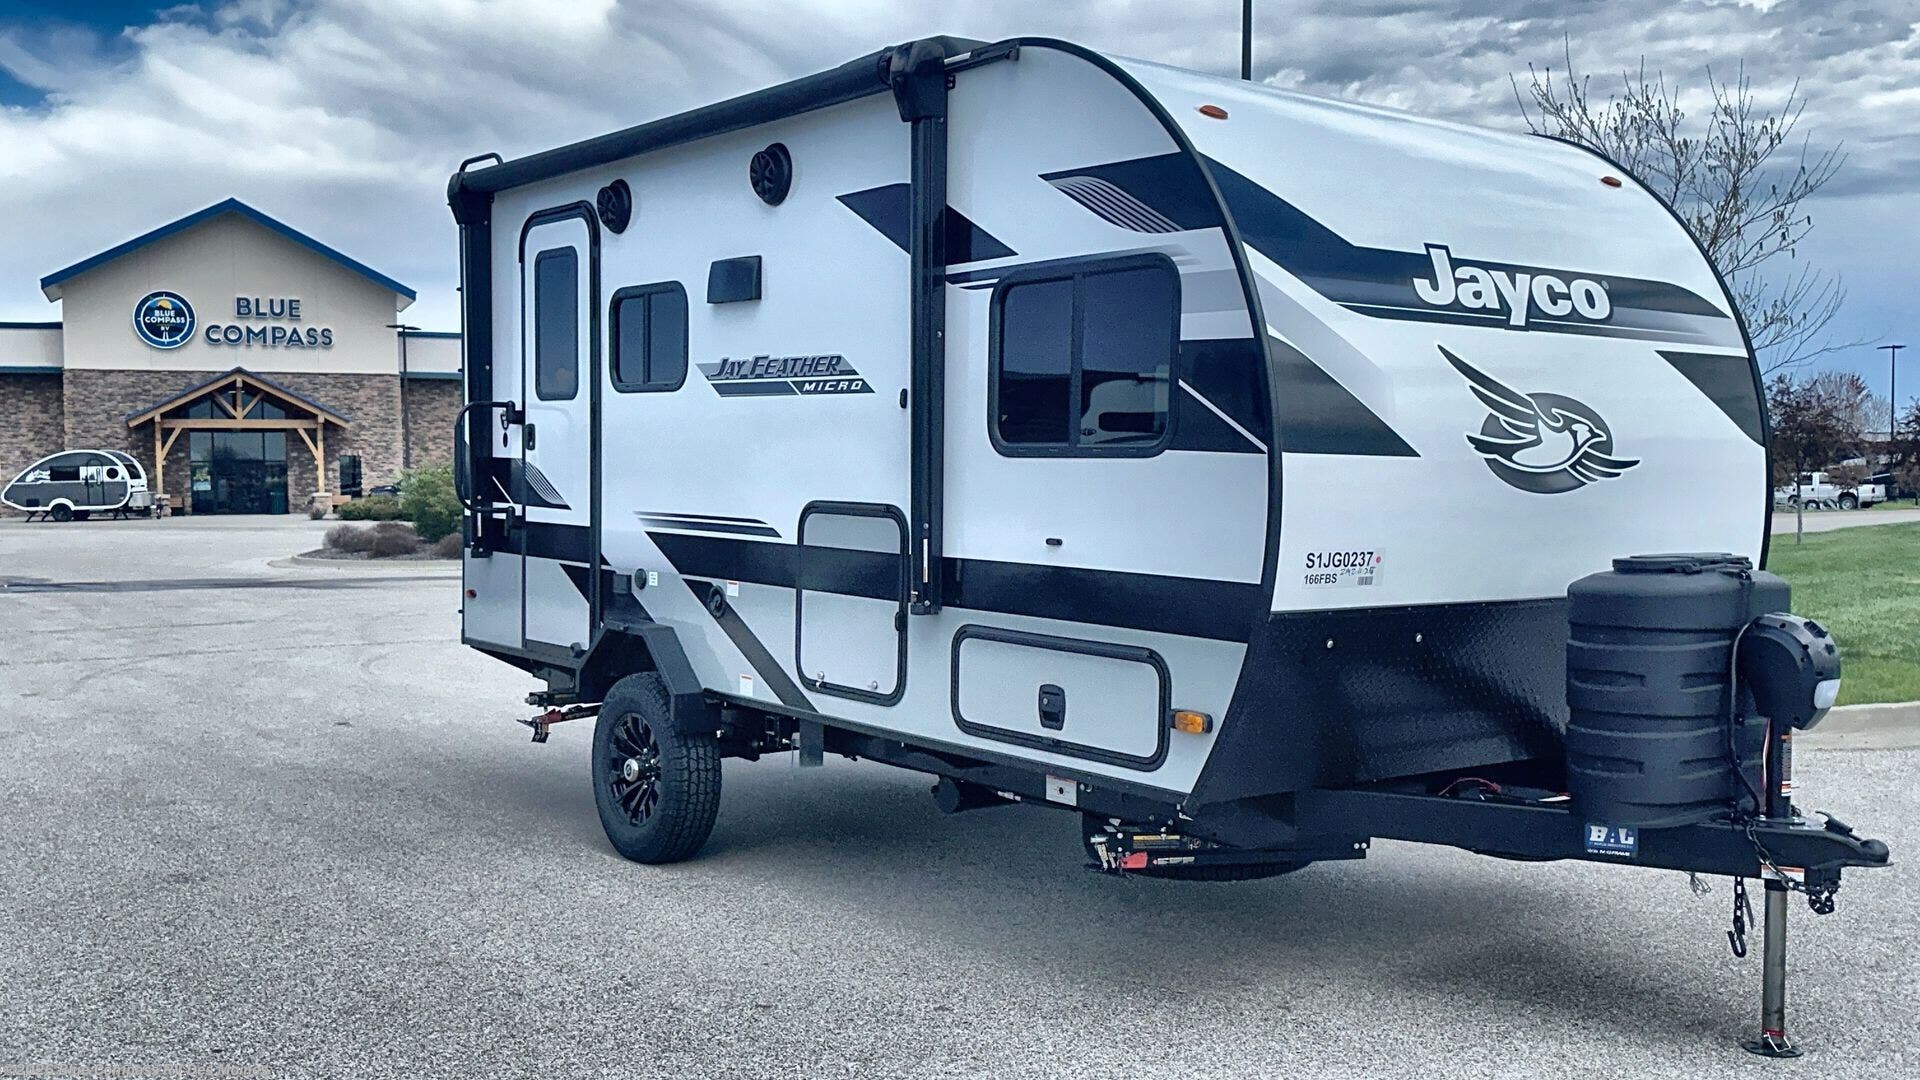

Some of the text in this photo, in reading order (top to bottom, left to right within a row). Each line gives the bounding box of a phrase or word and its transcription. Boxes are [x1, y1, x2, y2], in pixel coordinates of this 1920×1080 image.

[1413, 247, 1610, 327] Jayco
[154, 309, 176, 317] BLUE
[235, 296, 302, 318] BLUE
[145, 316, 186, 324] COMPASS
[205, 324, 334, 347] COMPASS
[709, 354, 843, 379] JAY FEATHER
[802, 380, 864, 392] MICRO
[1305, 551, 1374, 569] S1JG0237
[1303, 573, 1338, 585] 166FBS
[1589, 825, 1634, 844] BAL
